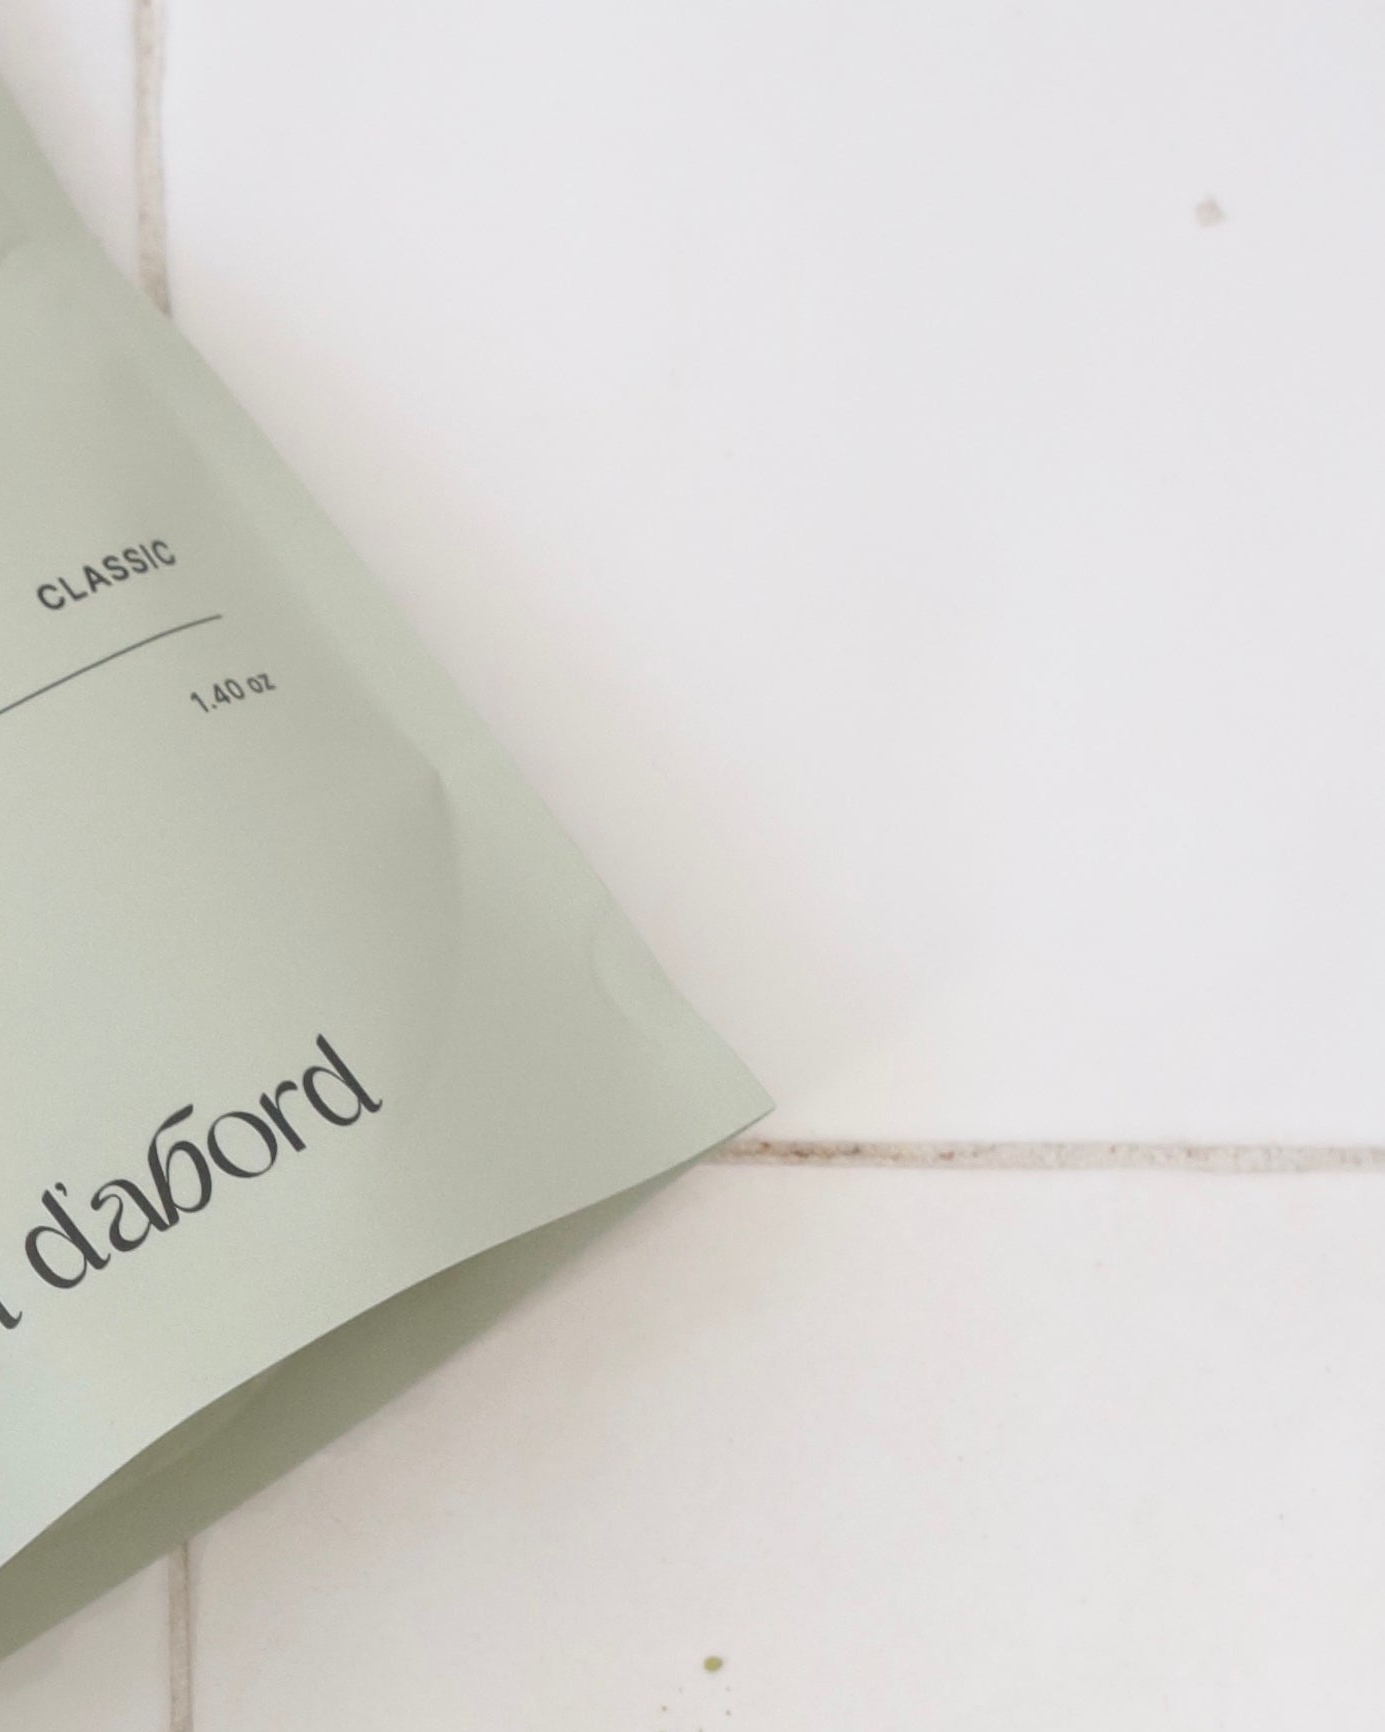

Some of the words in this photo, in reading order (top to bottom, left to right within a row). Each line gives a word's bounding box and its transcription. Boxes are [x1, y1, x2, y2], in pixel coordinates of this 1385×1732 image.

[36, 539, 177, 611] CLASSIC
[189, 677, 246, 714] 1.40
[247, 672, 277, 695] oz
[25, 1033, 383, 1290] d'abord
